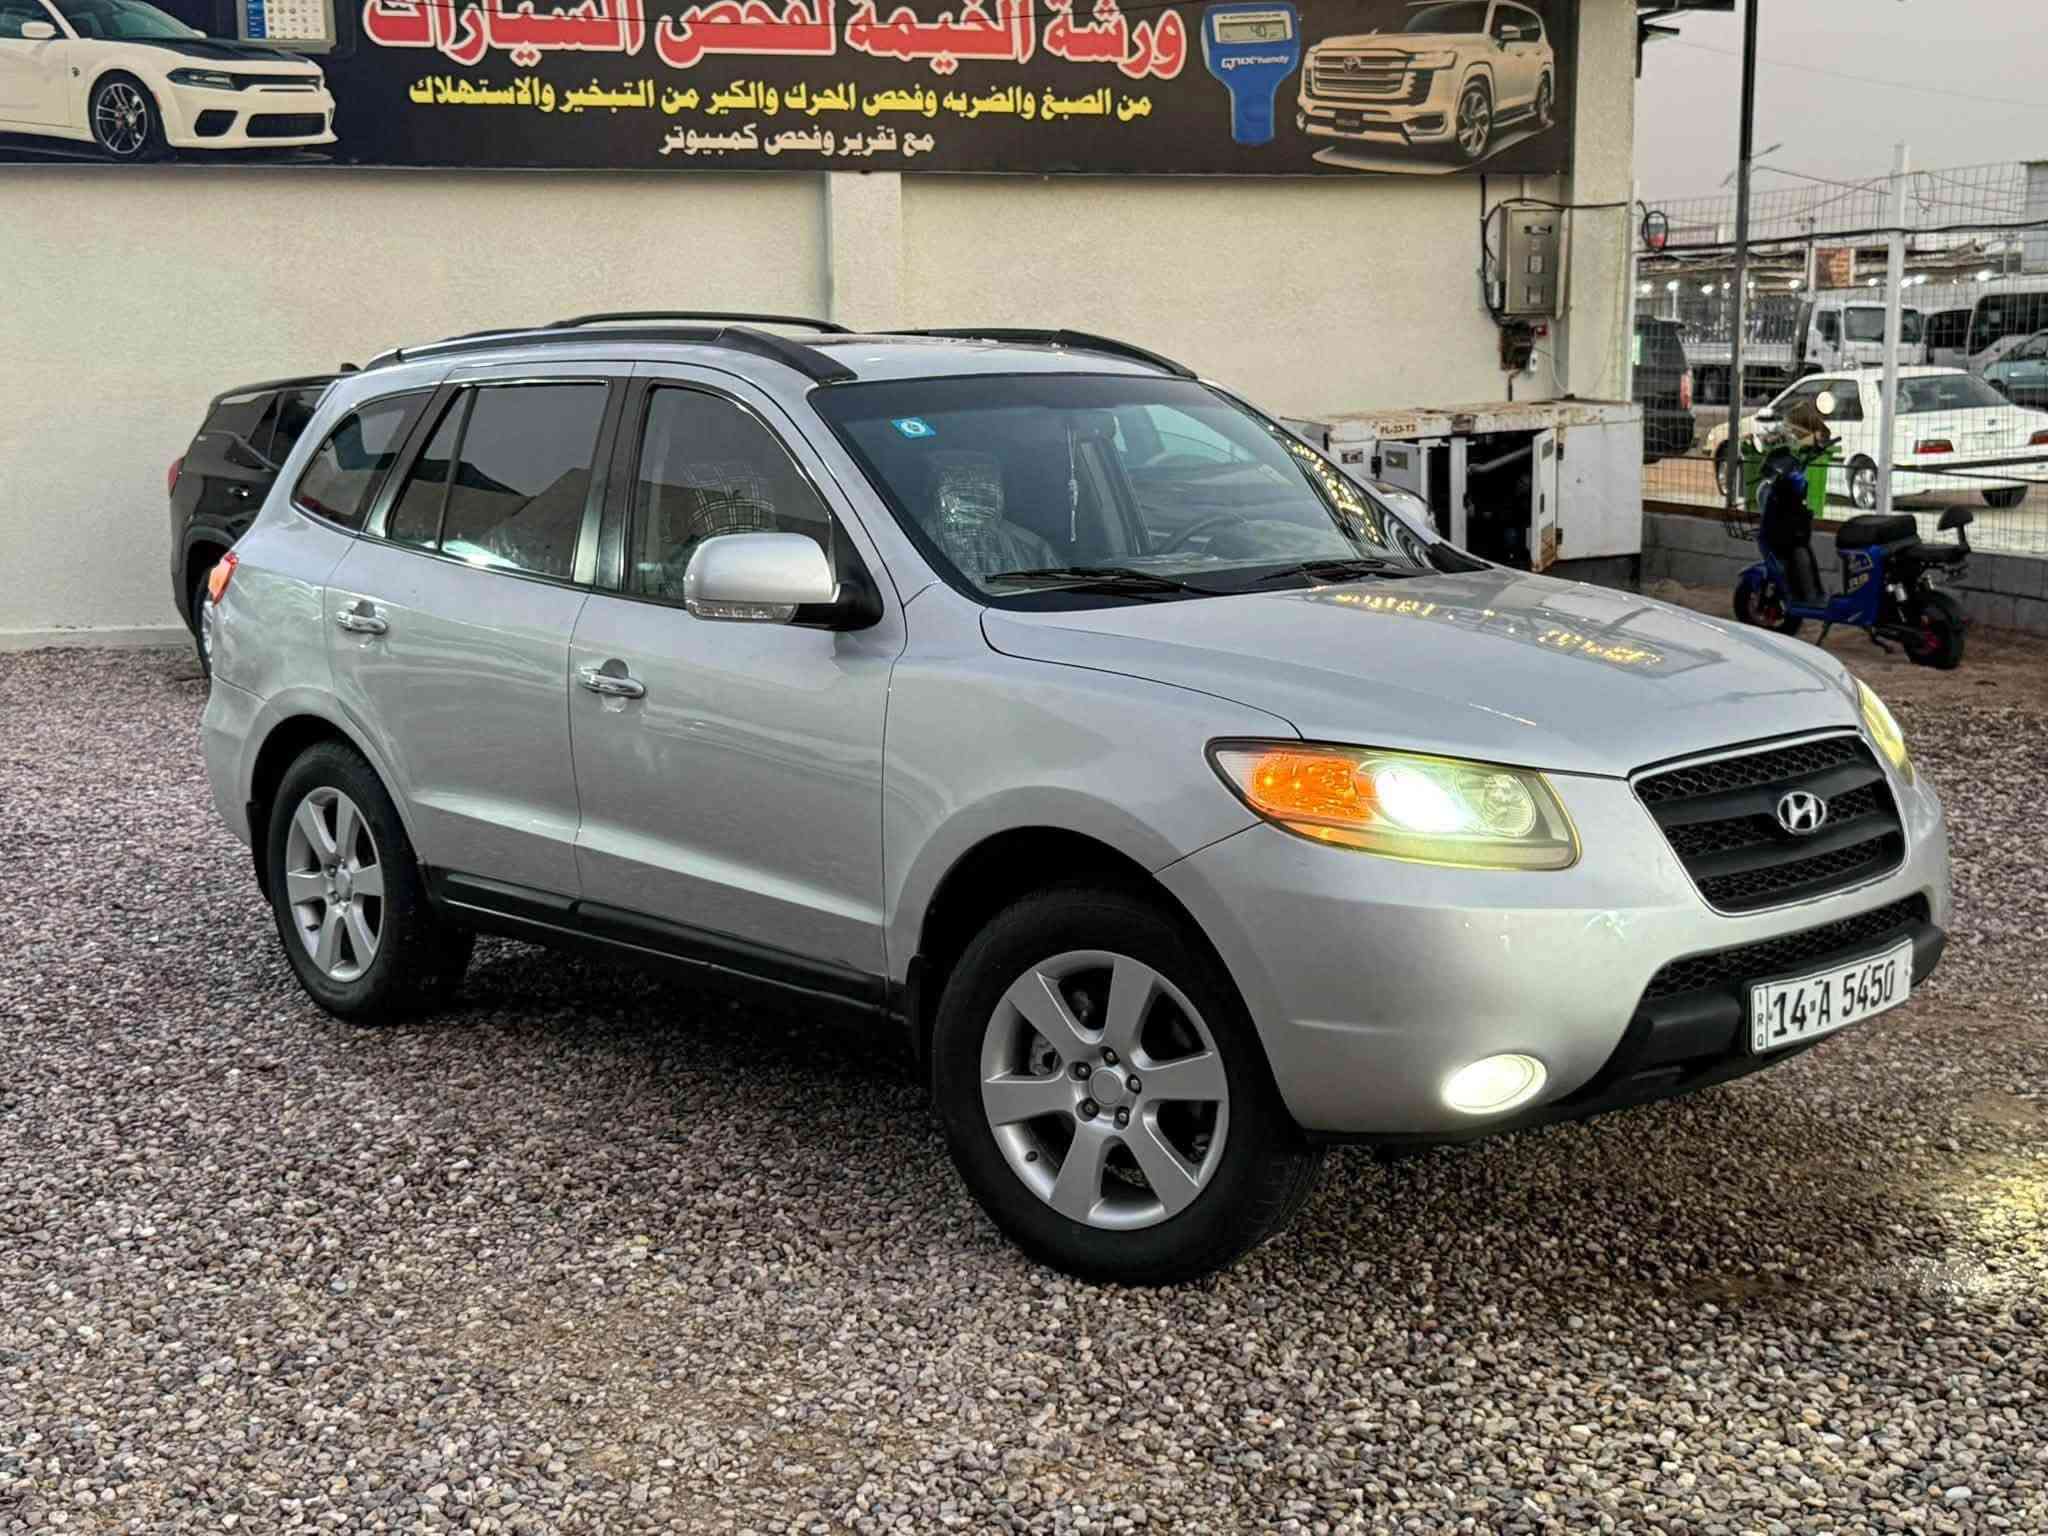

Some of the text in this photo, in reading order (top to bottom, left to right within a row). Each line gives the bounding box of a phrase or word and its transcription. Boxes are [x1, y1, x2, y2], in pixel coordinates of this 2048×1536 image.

[1043, 0, 1187, 79] ورشة
[409, 76, 1152, 121] من الصبغ والضربه وفحص المحرك والكير من التبخير والاستهلاك
[658, 122, 935, 157] مع تقرير وفحص كمبيوتر
[1772, 959, 1895, 1037] 14 A 5450
